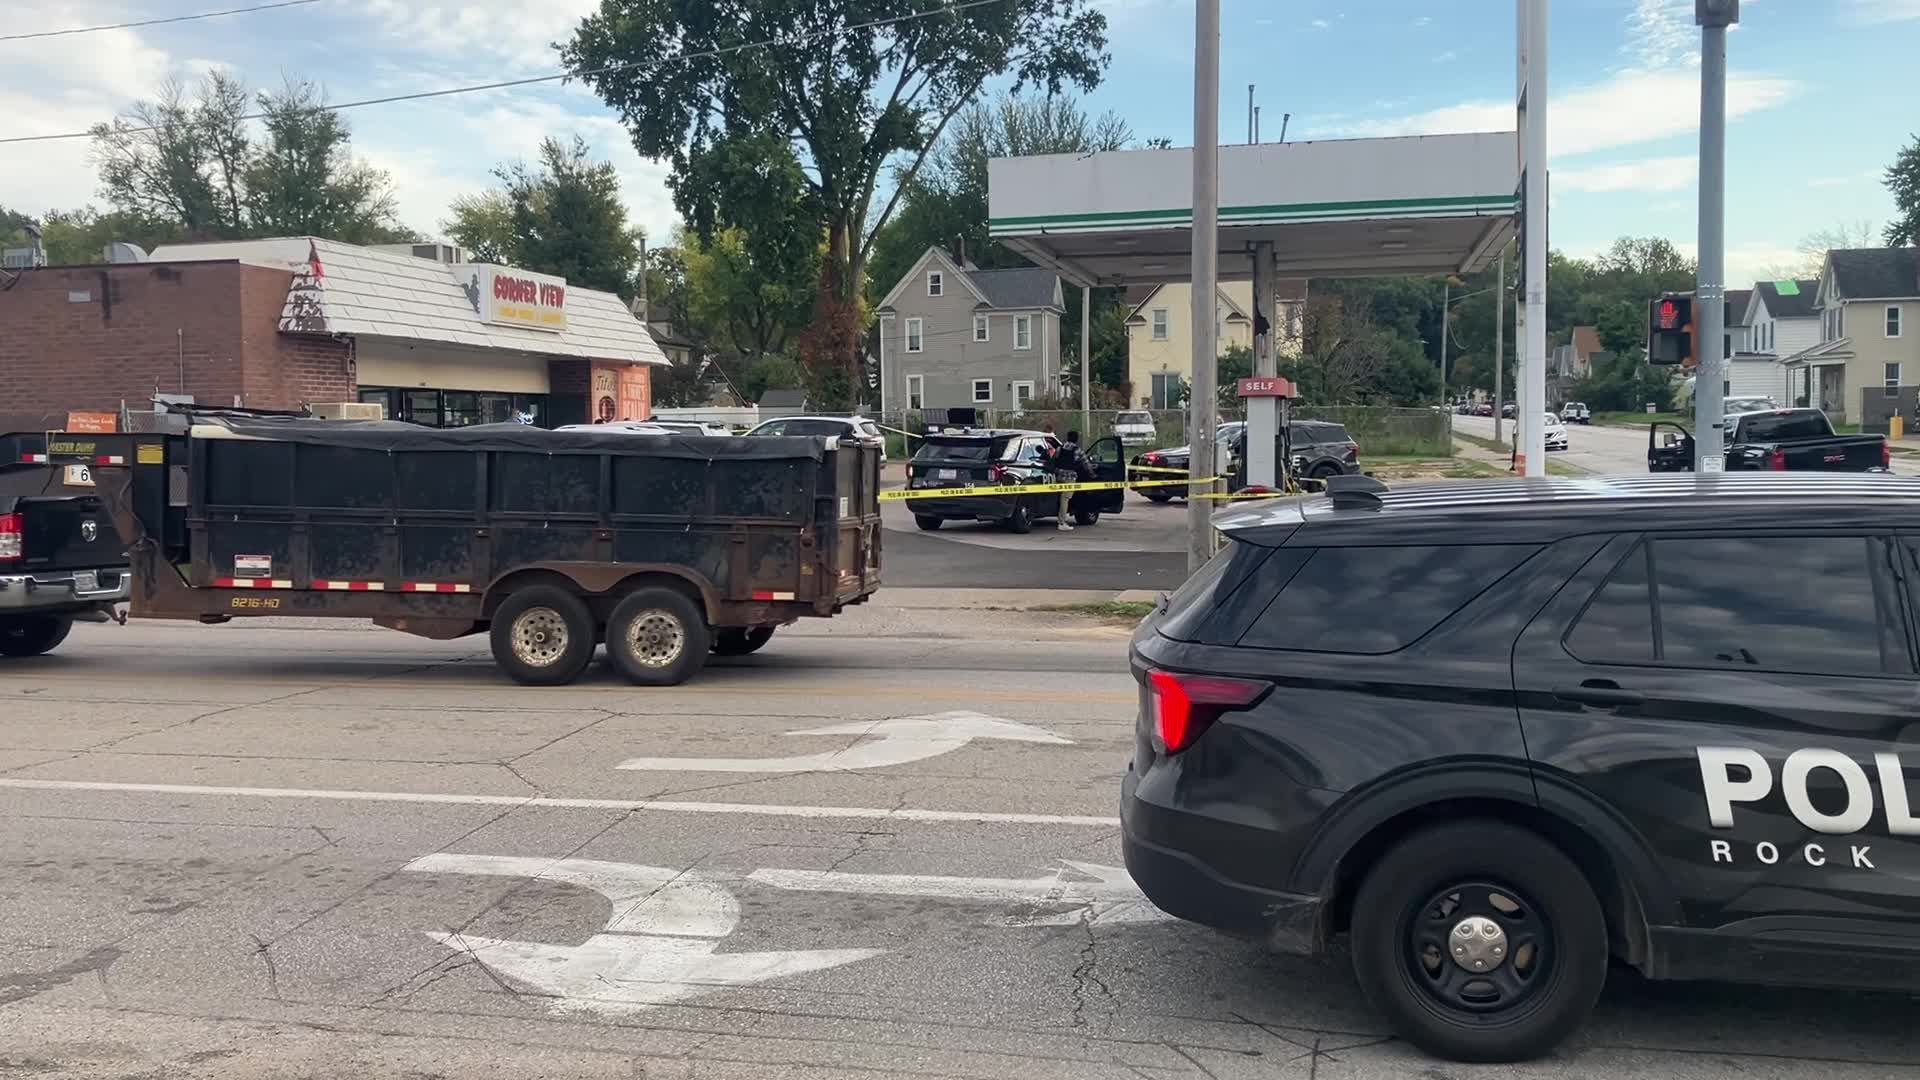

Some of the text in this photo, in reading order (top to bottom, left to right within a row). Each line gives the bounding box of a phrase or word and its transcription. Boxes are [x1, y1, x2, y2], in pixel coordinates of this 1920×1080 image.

[494, 274, 565, 309] CORNER VIEW
[1246, 382, 1274, 391] SELF
[231, 597, 280, 608] 8216-HD
[1696, 746, 1920, 835] POL
[1711, 840, 1875, 869] ROCK
